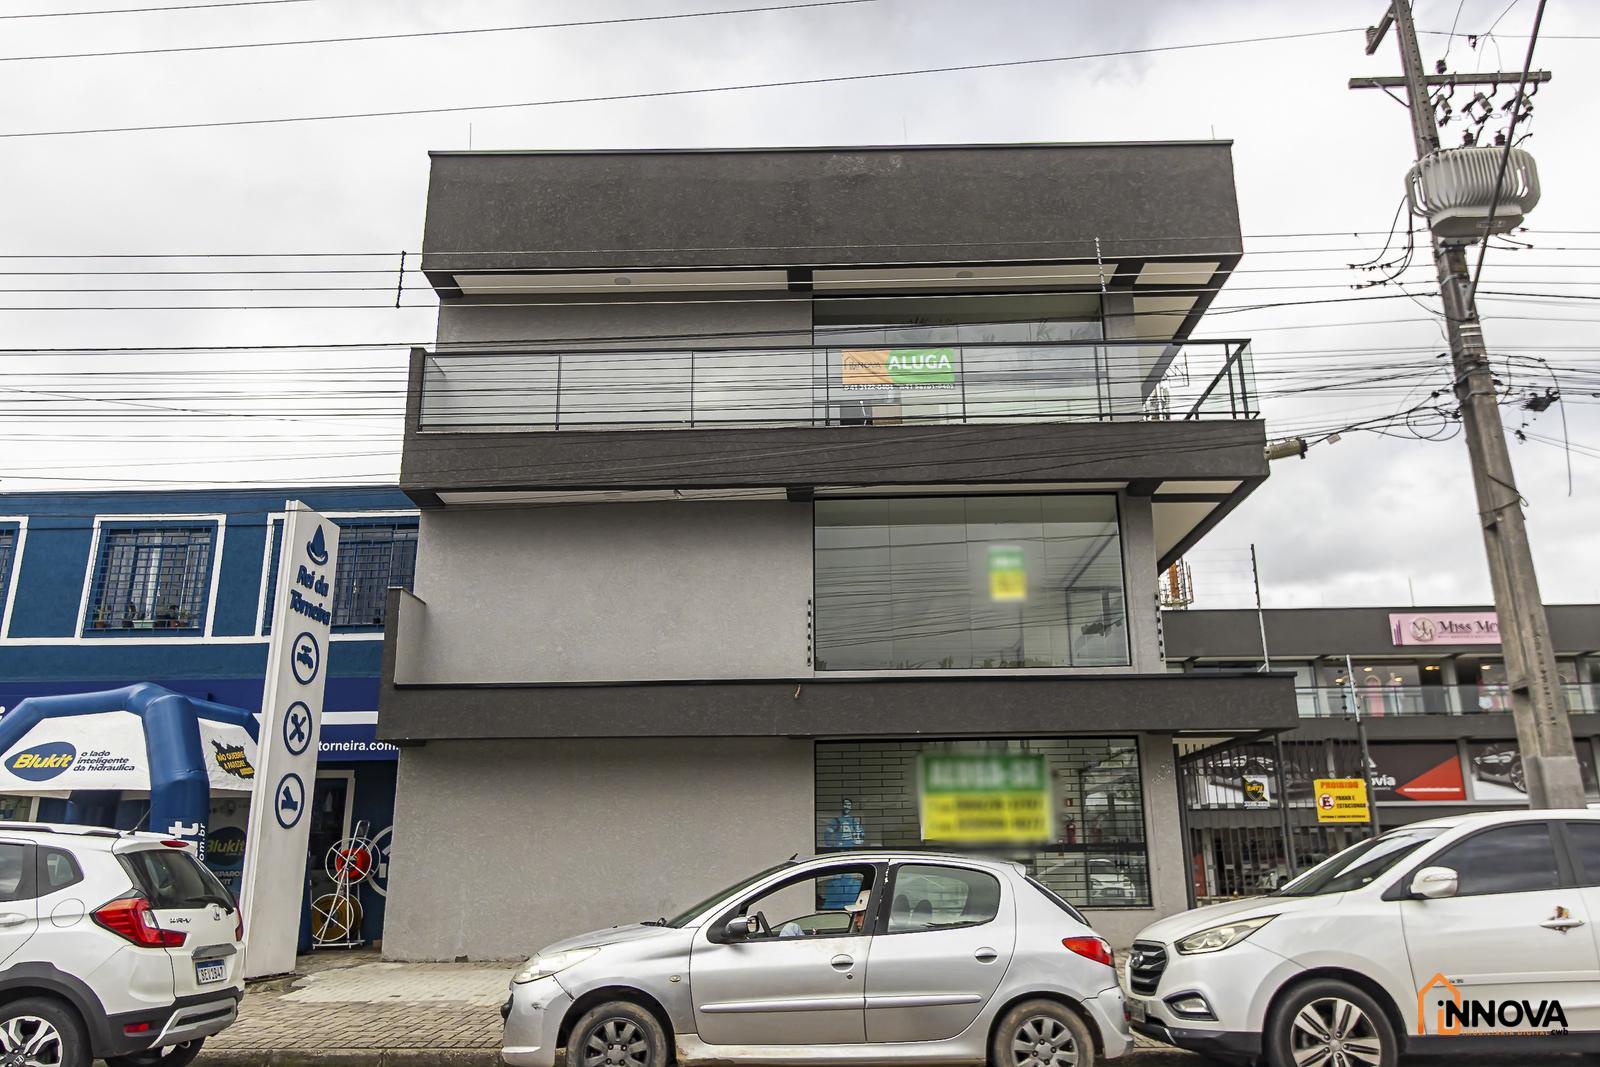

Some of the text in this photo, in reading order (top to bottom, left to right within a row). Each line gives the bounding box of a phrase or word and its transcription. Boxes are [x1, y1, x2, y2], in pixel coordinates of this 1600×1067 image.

[888, 354, 951, 370] ALUGA
[296, 565, 329, 597] Rei da
[290, 589, 331, 626] Torneira
[13, 753, 73, 769] Blukit
[73, 764, 86, 772] da
[77, 757, 129, 766] inteligente
